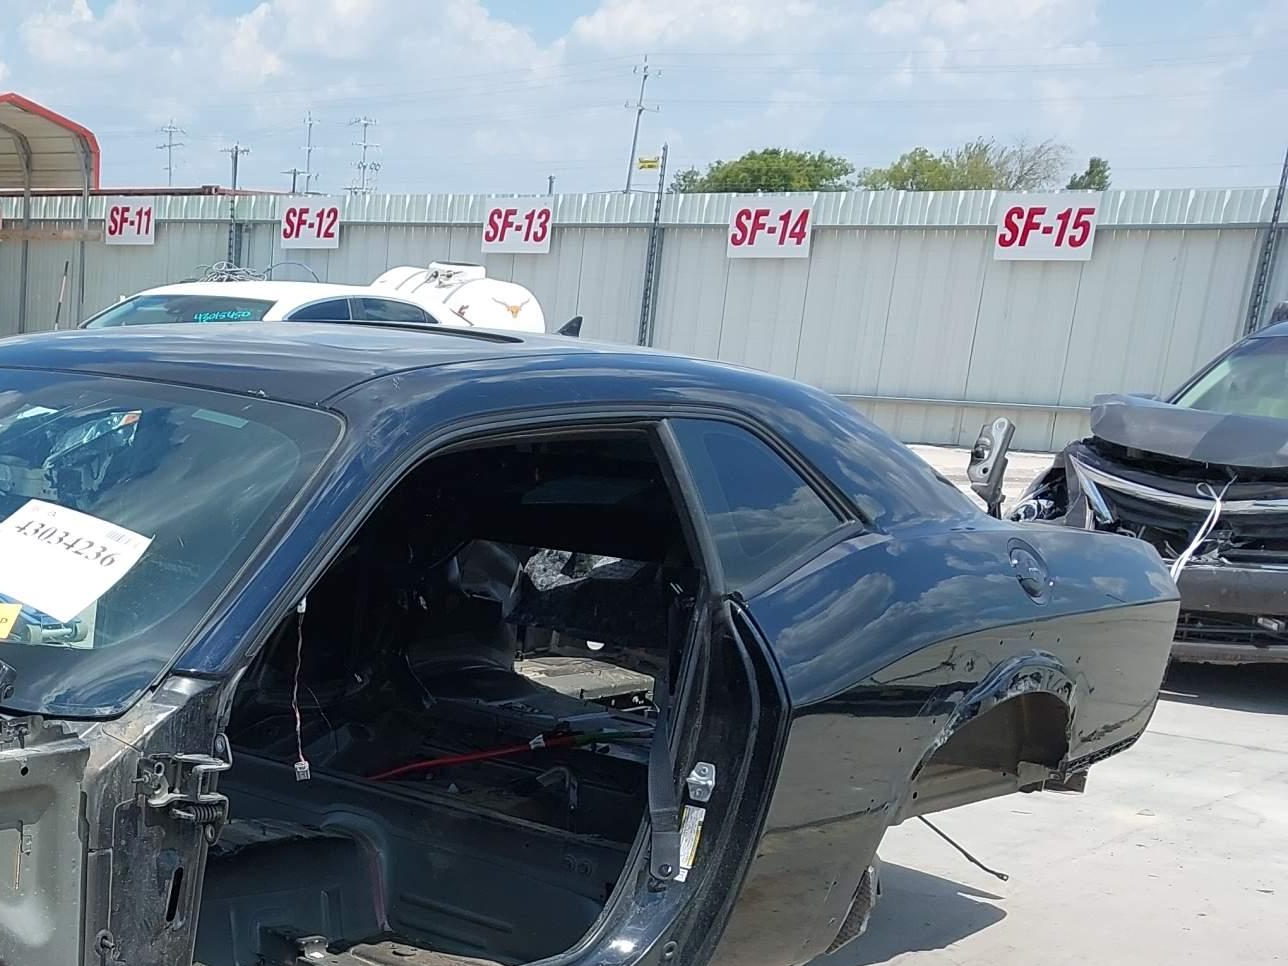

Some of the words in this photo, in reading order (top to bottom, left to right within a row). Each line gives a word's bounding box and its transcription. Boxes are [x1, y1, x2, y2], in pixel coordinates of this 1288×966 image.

[108, 206, 151, 235] SF-11
[283, 207, 339, 238] SF-12
[484, 208, 551, 242] SF-13
[730, 208, 810, 246] SF-14
[998, 206, 1096, 248] SF-15
[15, 520, 120, 567] 43034236
